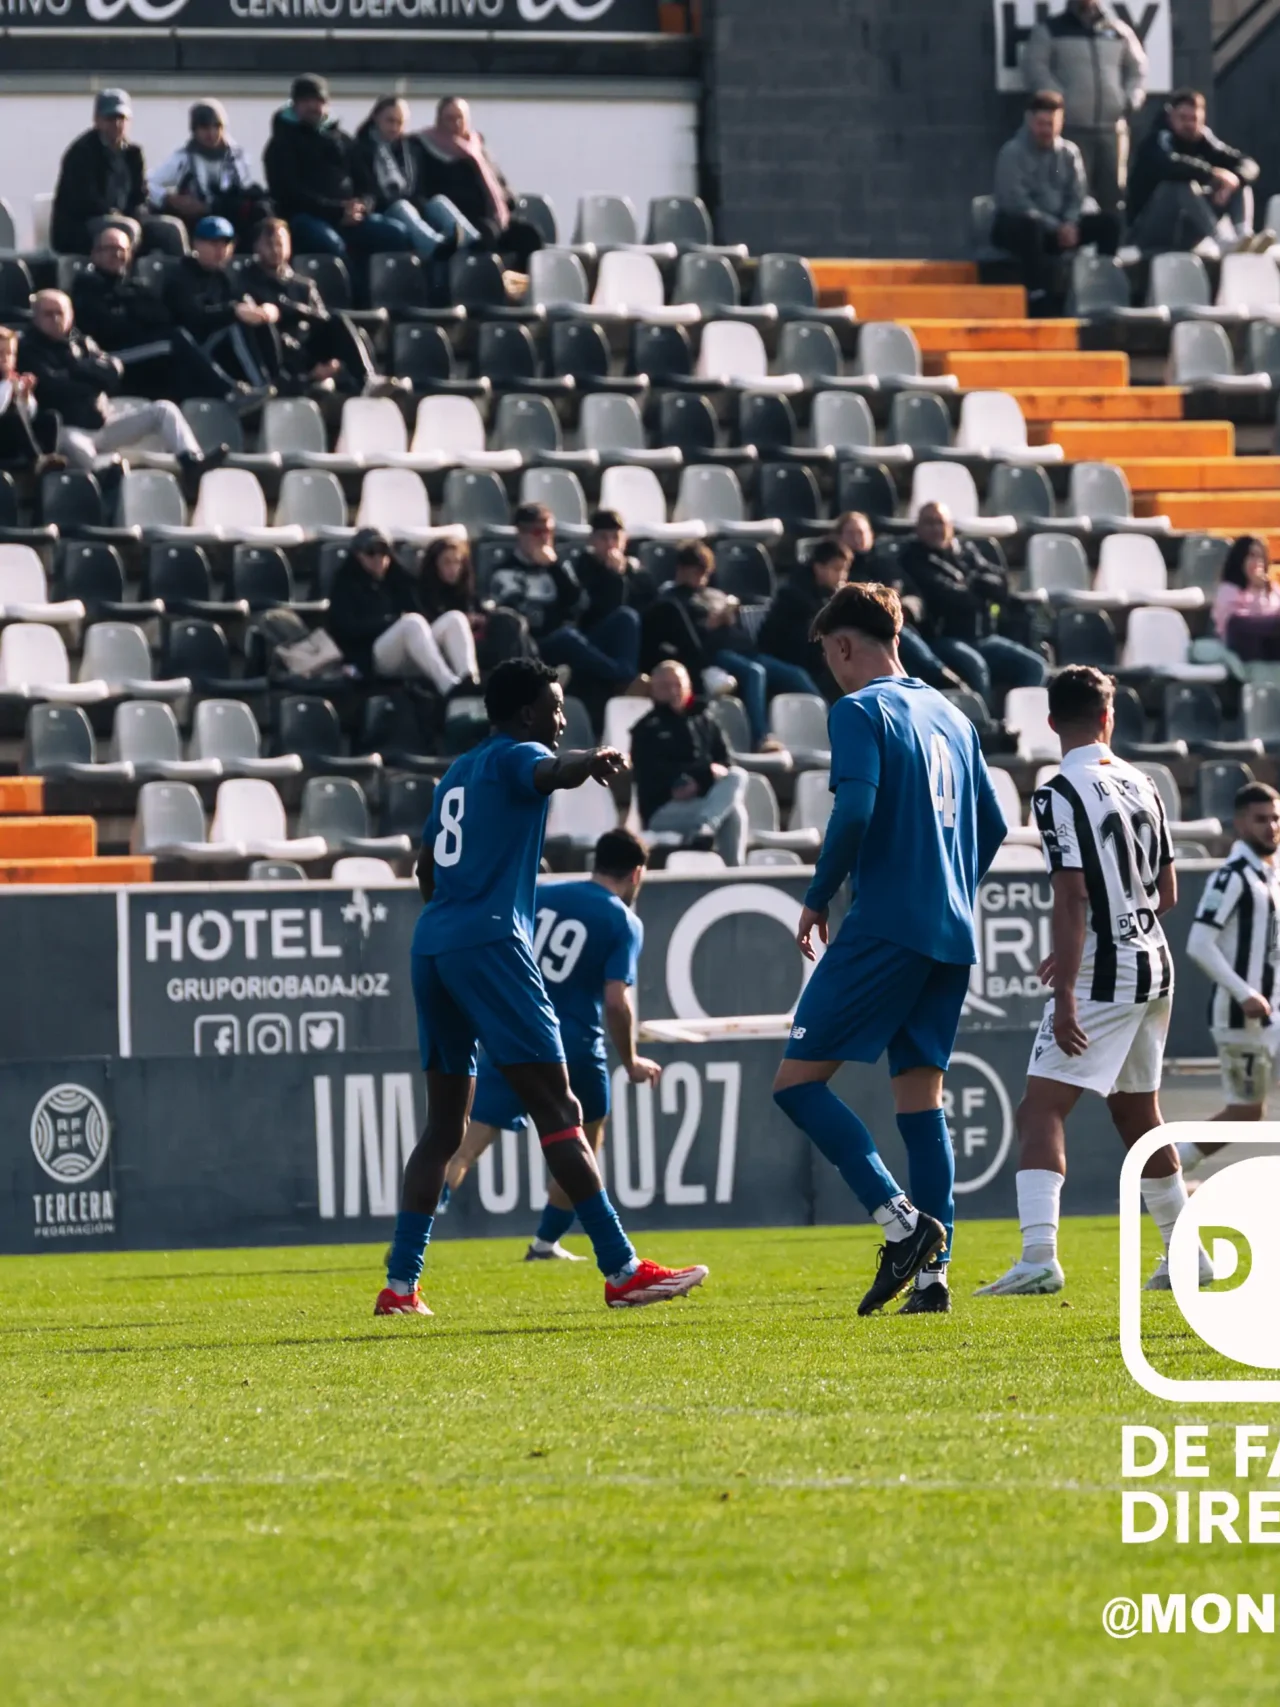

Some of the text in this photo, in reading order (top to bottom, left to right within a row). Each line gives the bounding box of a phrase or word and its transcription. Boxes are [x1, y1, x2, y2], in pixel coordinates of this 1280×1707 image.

[1002, 2, 1159, 68] HY
[929, 733, 957, 829] 4
[433, 786, 465, 868] 8
[1099, 808, 1162, 900] 10
[980, 882, 1055, 912] GRU
[145, 908, 343, 962] HOTEL
[533, 907, 589, 984] 19
[985, 915, 1051, 973] RI
[166, 973, 390, 1002] GRUPORIOBADAJOZ
[33, 1190, 114, 1224] TERCERA
